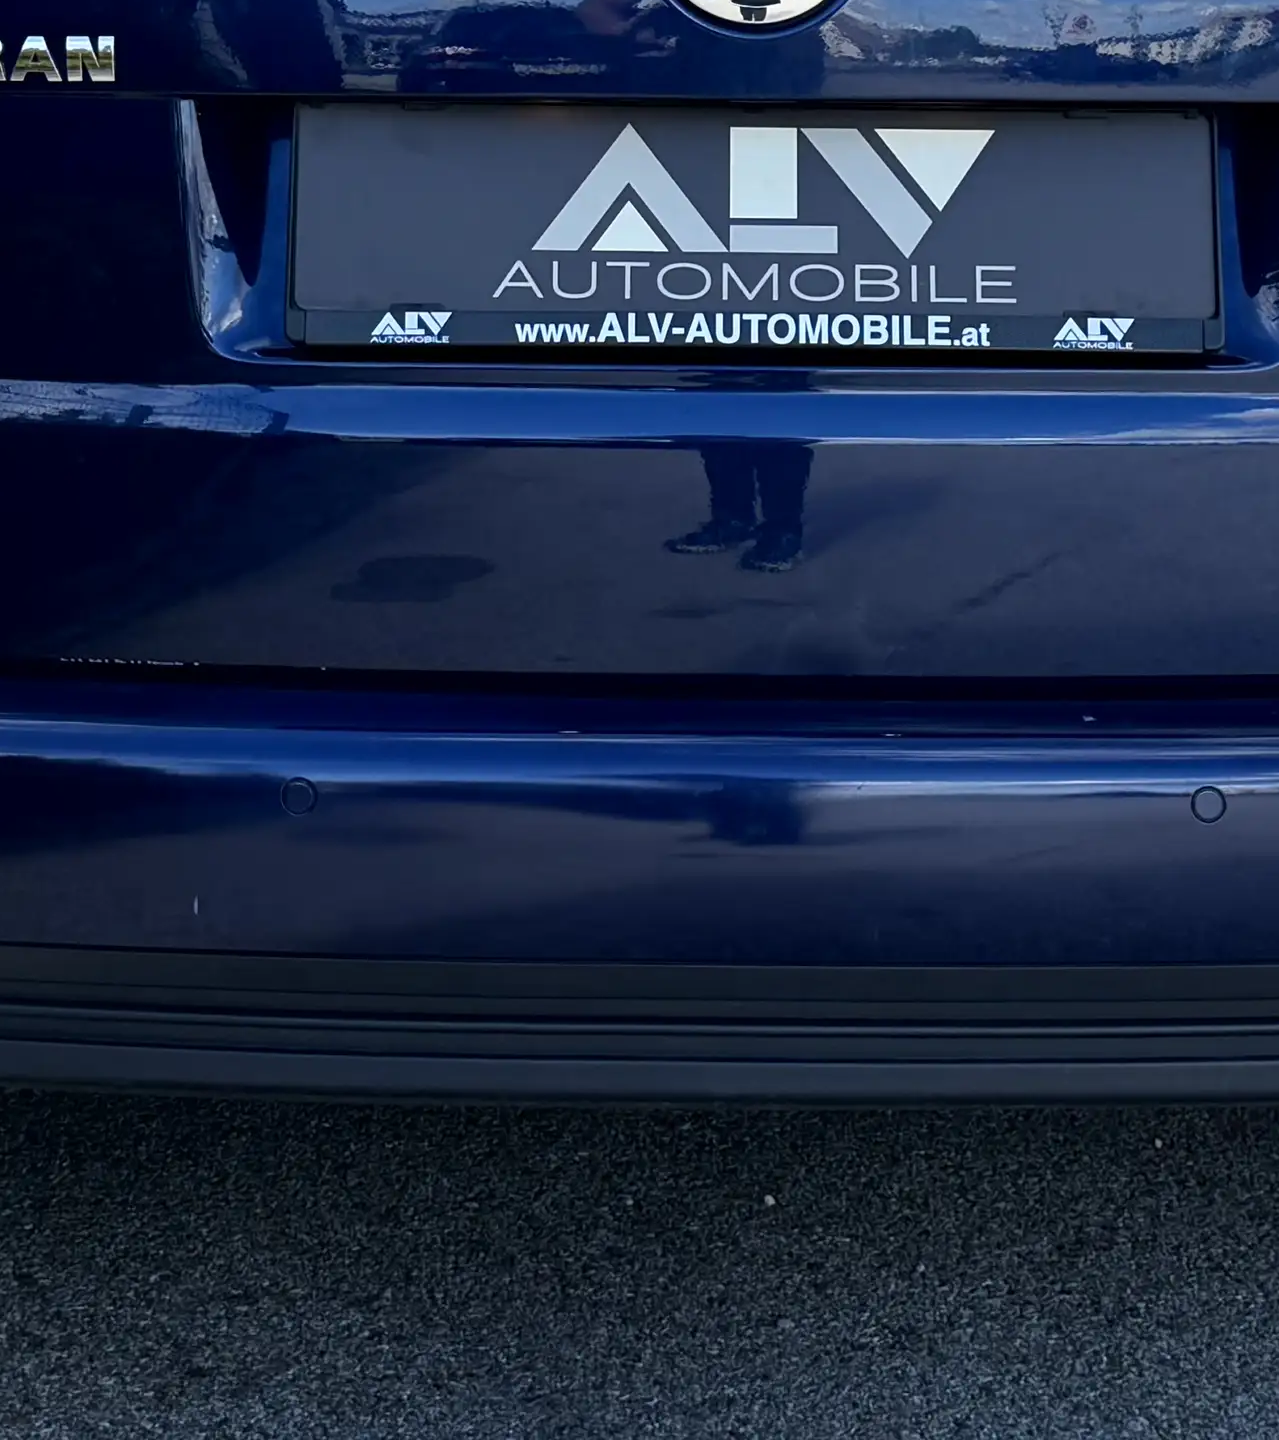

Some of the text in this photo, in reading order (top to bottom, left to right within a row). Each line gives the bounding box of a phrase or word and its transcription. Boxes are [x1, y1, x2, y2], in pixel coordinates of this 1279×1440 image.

[531, 122, 996, 259] ALV
[492, 260, 1018, 304] AUTOMOBILE
[370, 311, 453, 336] ALV
[514, 312, 991, 348] www.ALV-AUTOMOBILE.at
[1053, 317, 1135, 341] ALV
[370, 335, 450, 344] AUTOMOBILE
[1053, 341, 1134, 350] AUTOMOBILE
